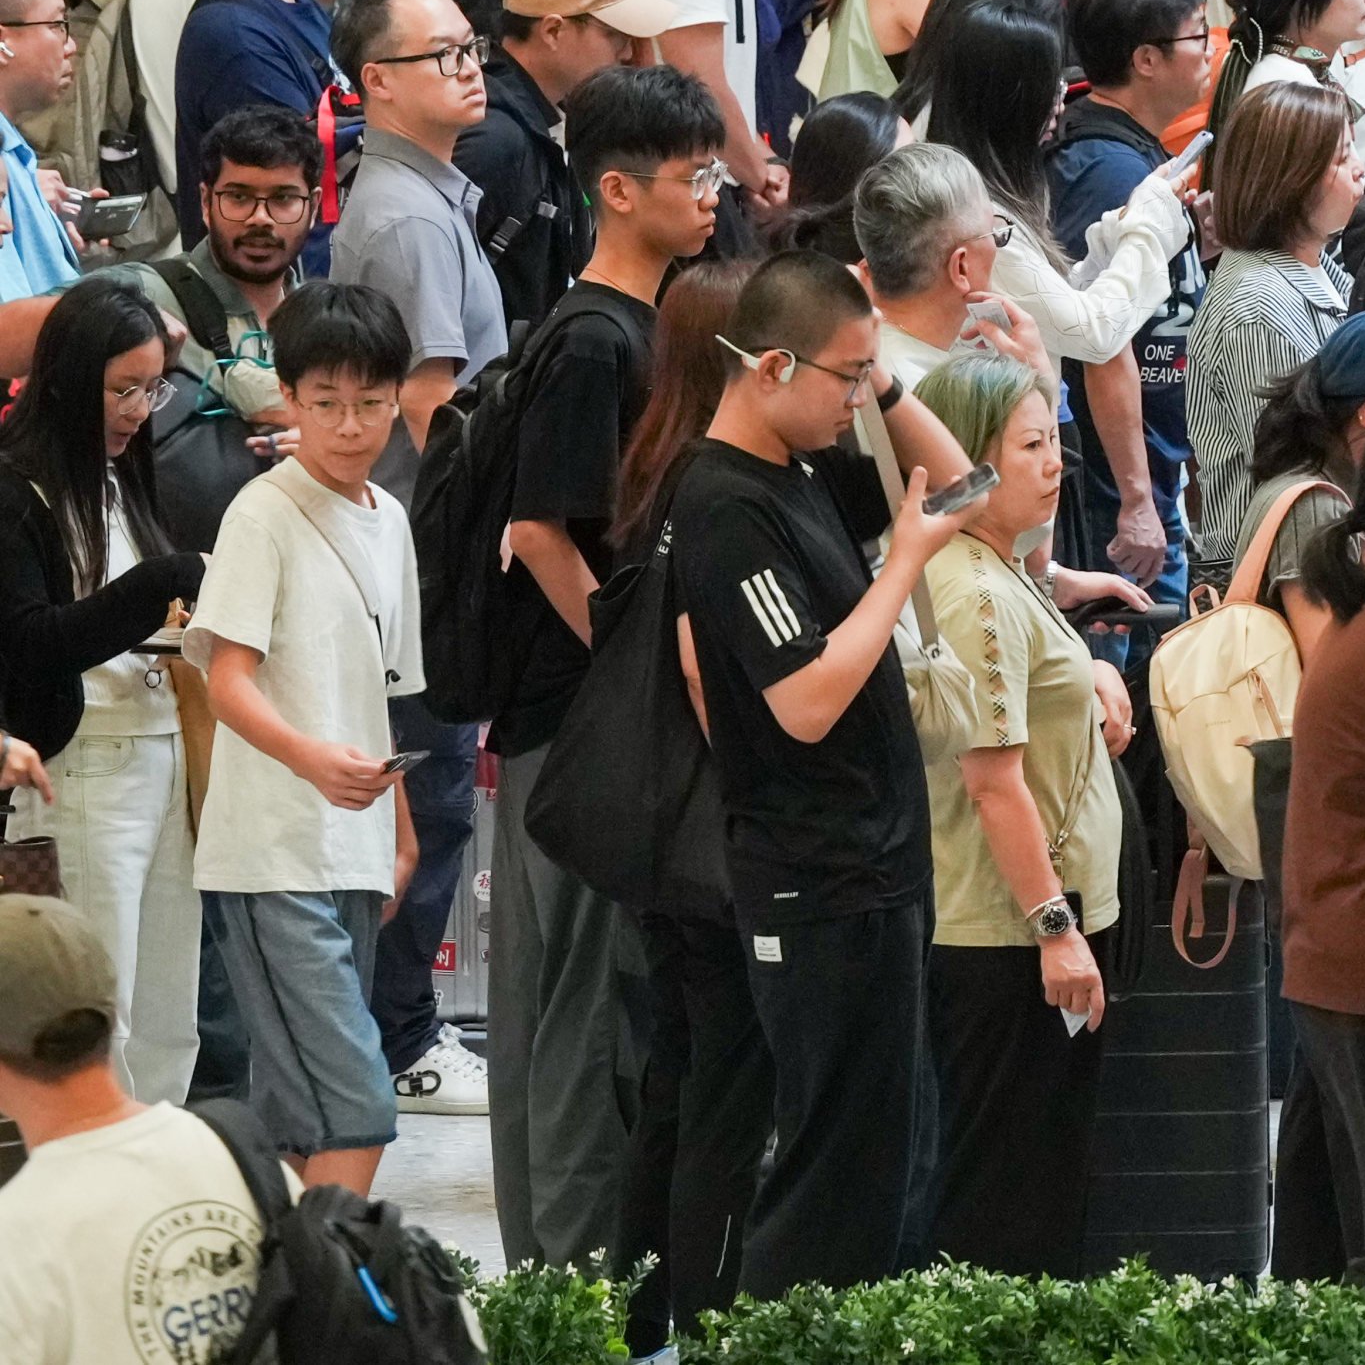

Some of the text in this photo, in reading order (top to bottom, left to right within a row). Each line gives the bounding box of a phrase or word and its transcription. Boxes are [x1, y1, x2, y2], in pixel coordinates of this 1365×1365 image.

[1144, 344, 1175, 361] ONE
[133, 1209, 194, 1306] MOUNTAINS
[205, 1209, 240, 1229] ARE
[163, 1284, 252, 1343] GERR
